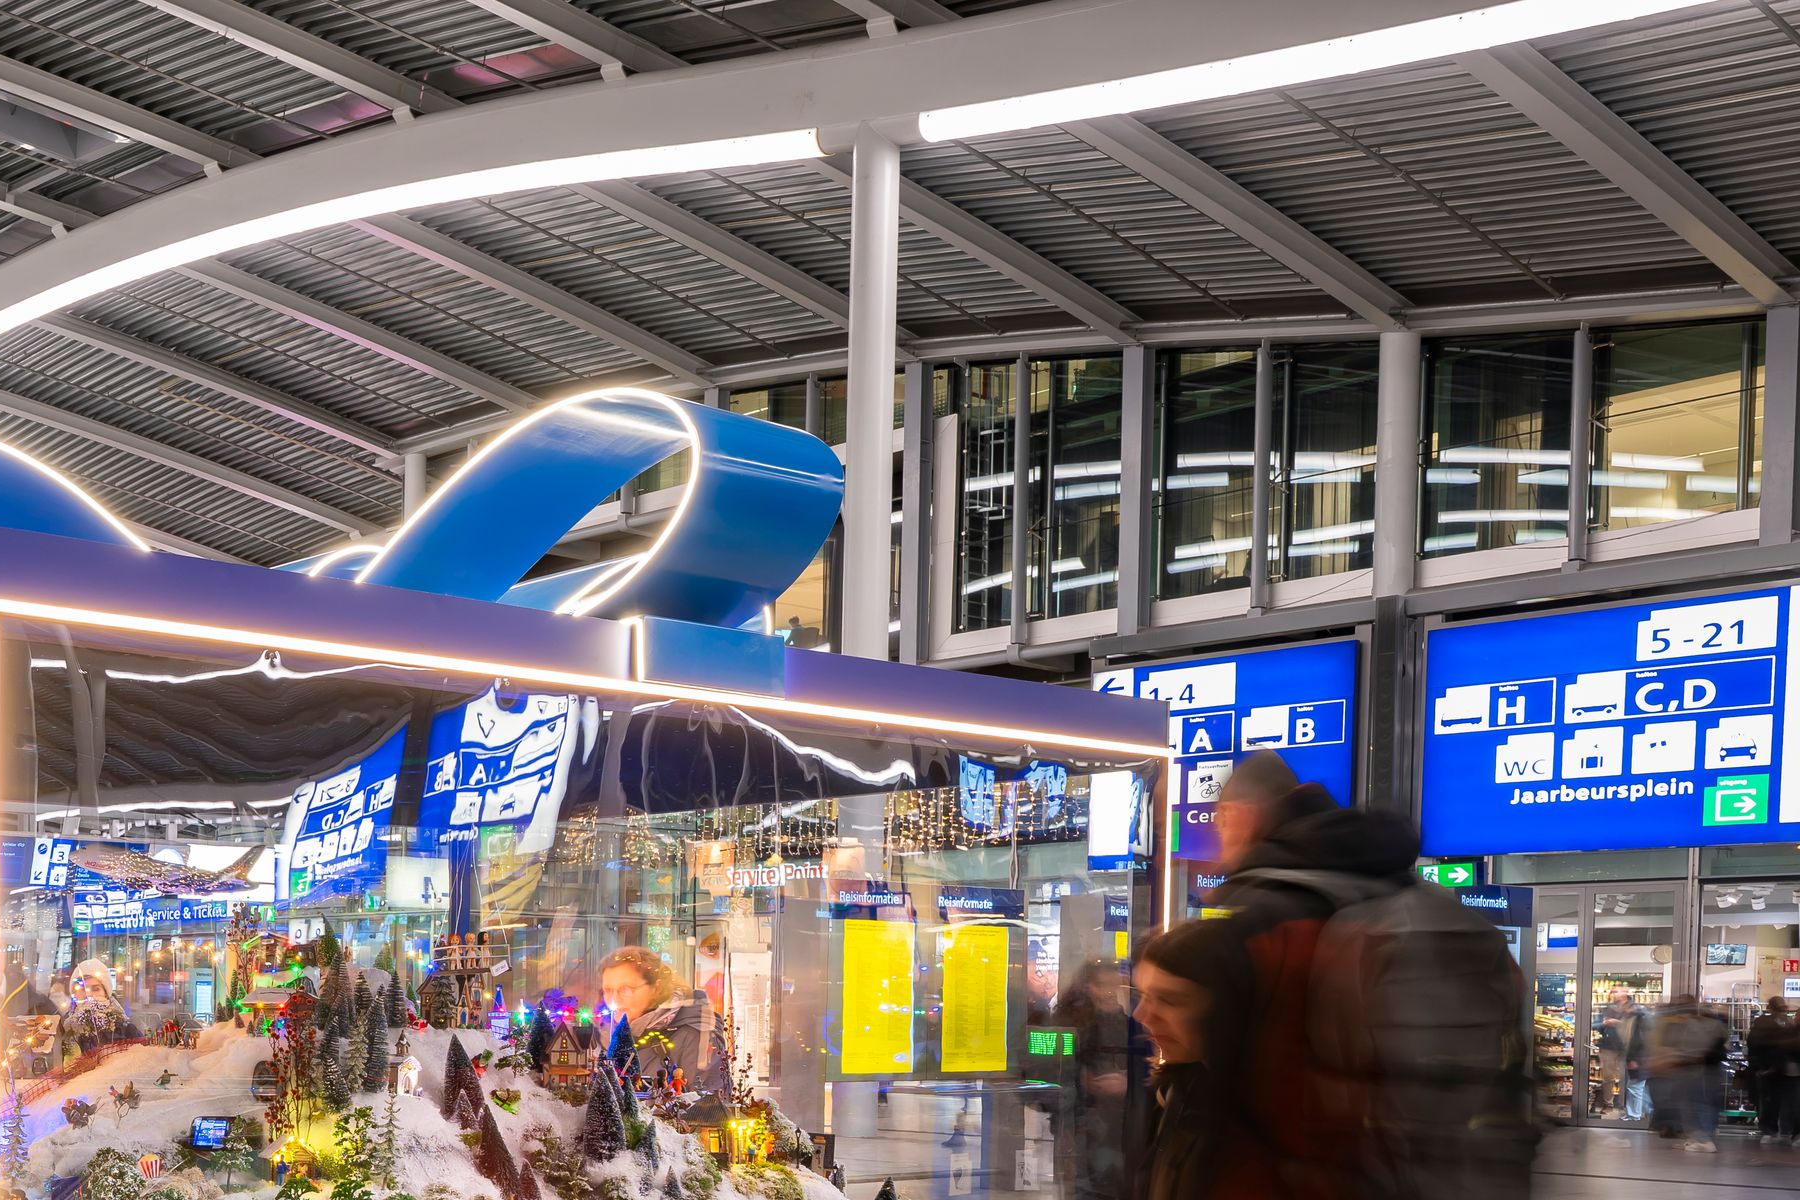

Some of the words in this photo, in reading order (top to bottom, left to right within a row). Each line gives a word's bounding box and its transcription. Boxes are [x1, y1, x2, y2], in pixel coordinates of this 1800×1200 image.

[1496, 695, 1527, 726] H
[1188, 727, 1214, 753] A
[1294, 717, 1316, 744] B
[1503, 757, 1547, 778] WC
[1509, 777, 1694, 806] Jaarbeursplein
[724, 863, 777, 888] Service
[784, 861, 826, 882] Point
[839, 890, 900, 905] Reisinformatie
[1461, 894, 1508, 909] Reisinformatie
[146, 907, 181, 921] Service
[183, 906, 192, 919] &
